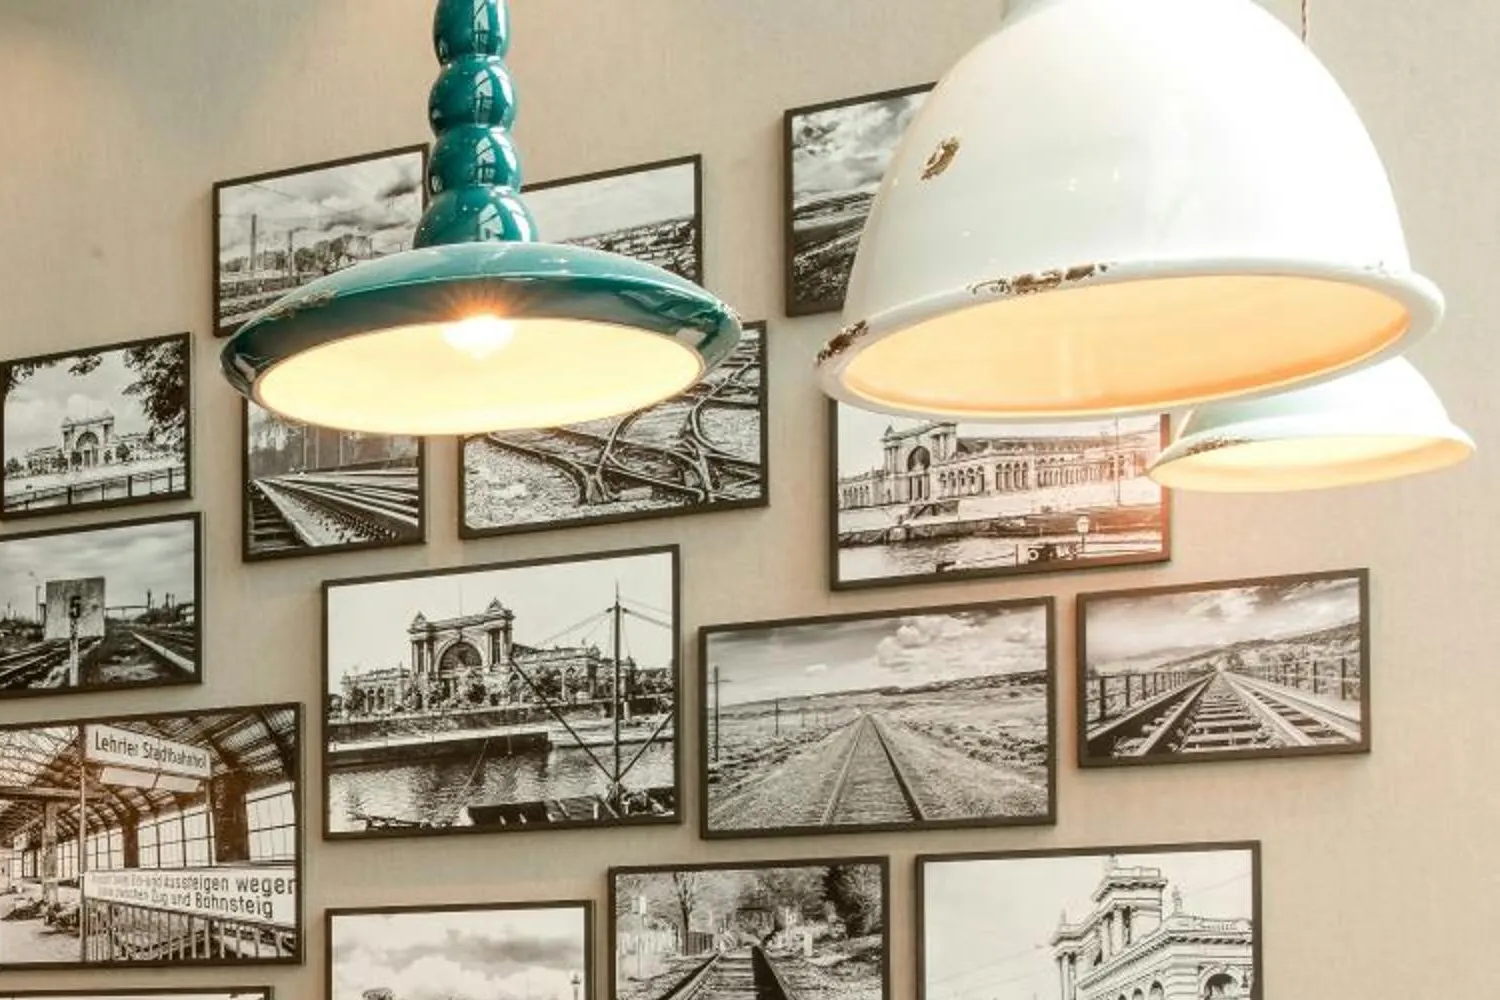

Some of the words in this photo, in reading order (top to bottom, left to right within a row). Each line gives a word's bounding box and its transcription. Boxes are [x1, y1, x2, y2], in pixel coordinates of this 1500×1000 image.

[69, 595, 81, 619] 5
[94, 730, 139, 757] Lehrter
[194, 891, 273, 919] Bahnsteig
